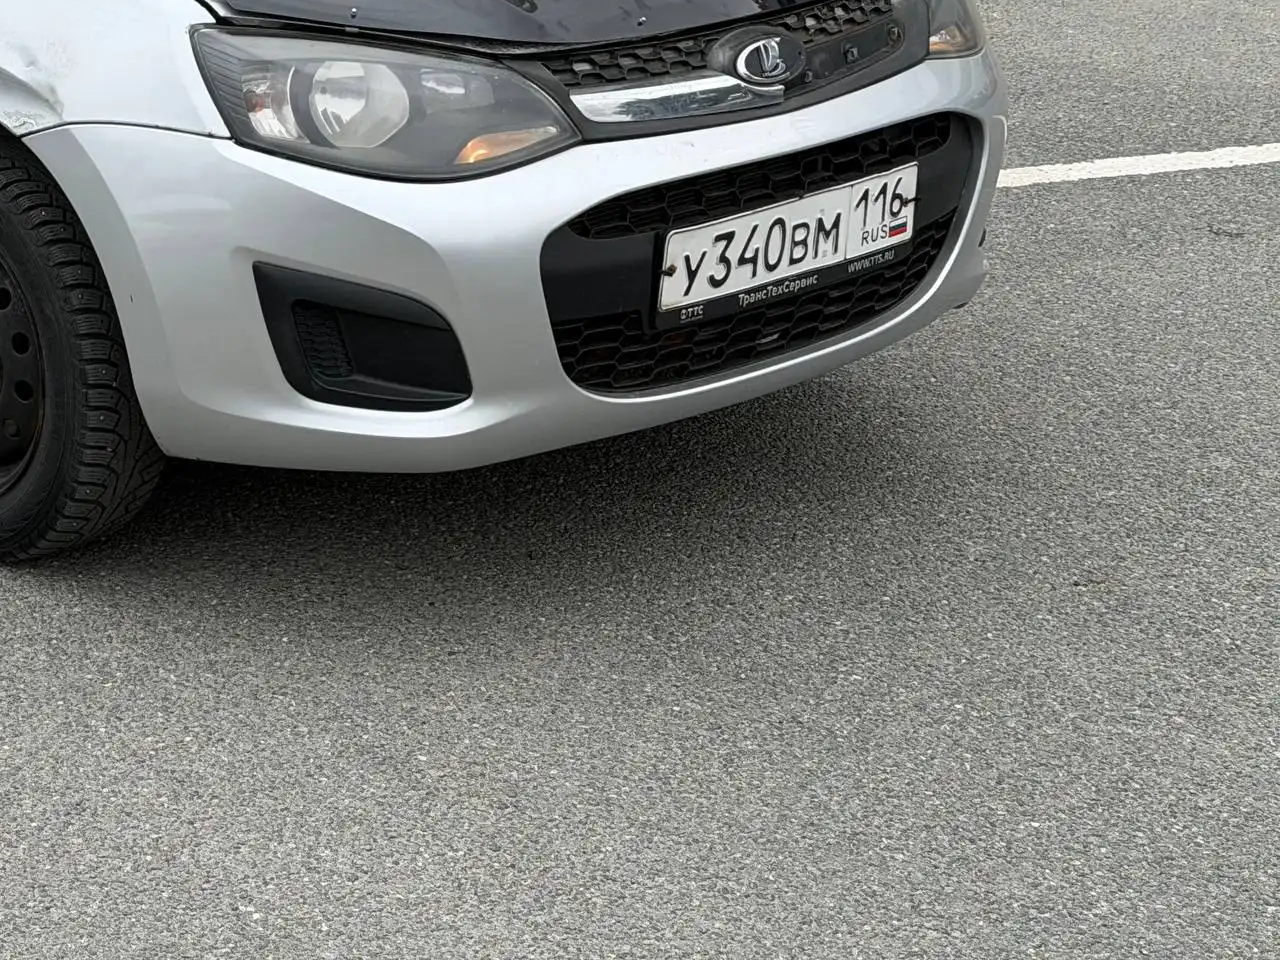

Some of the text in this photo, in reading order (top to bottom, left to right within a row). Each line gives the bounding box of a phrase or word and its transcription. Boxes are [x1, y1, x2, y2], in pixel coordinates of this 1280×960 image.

[854, 176, 905, 227] 116
[860, 224, 888, 247] RUS
[738, 274, 819, 307] ТрансТехСервис
